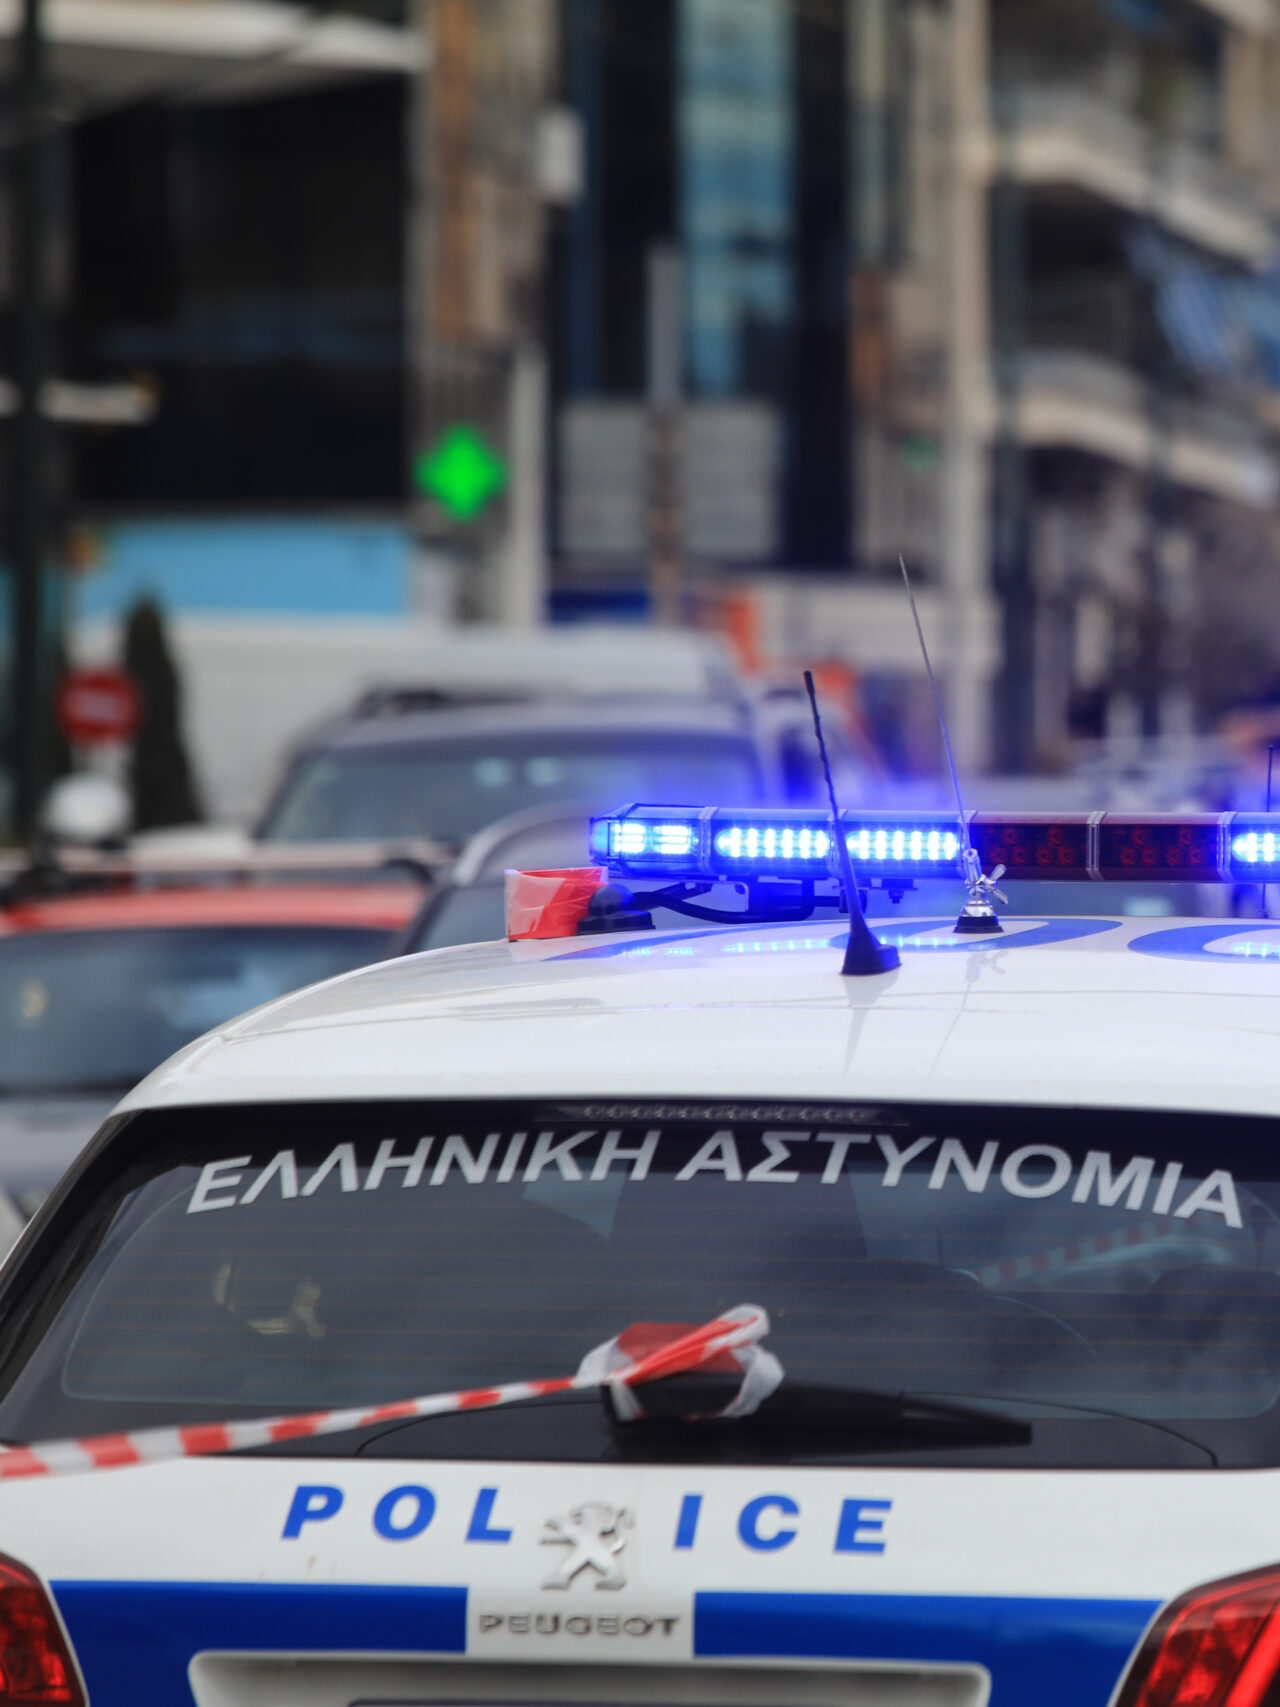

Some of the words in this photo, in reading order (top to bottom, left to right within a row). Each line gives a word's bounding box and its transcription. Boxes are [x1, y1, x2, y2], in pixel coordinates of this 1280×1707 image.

[186, 1130, 662, 1215] ΕΛΛΗΝΙΚΗ
[673, 1130, 1243, 1229] ΑΣΤΥΝΟΜΙΑ
[479, 1613, 680, 1636] PEUGEOT
